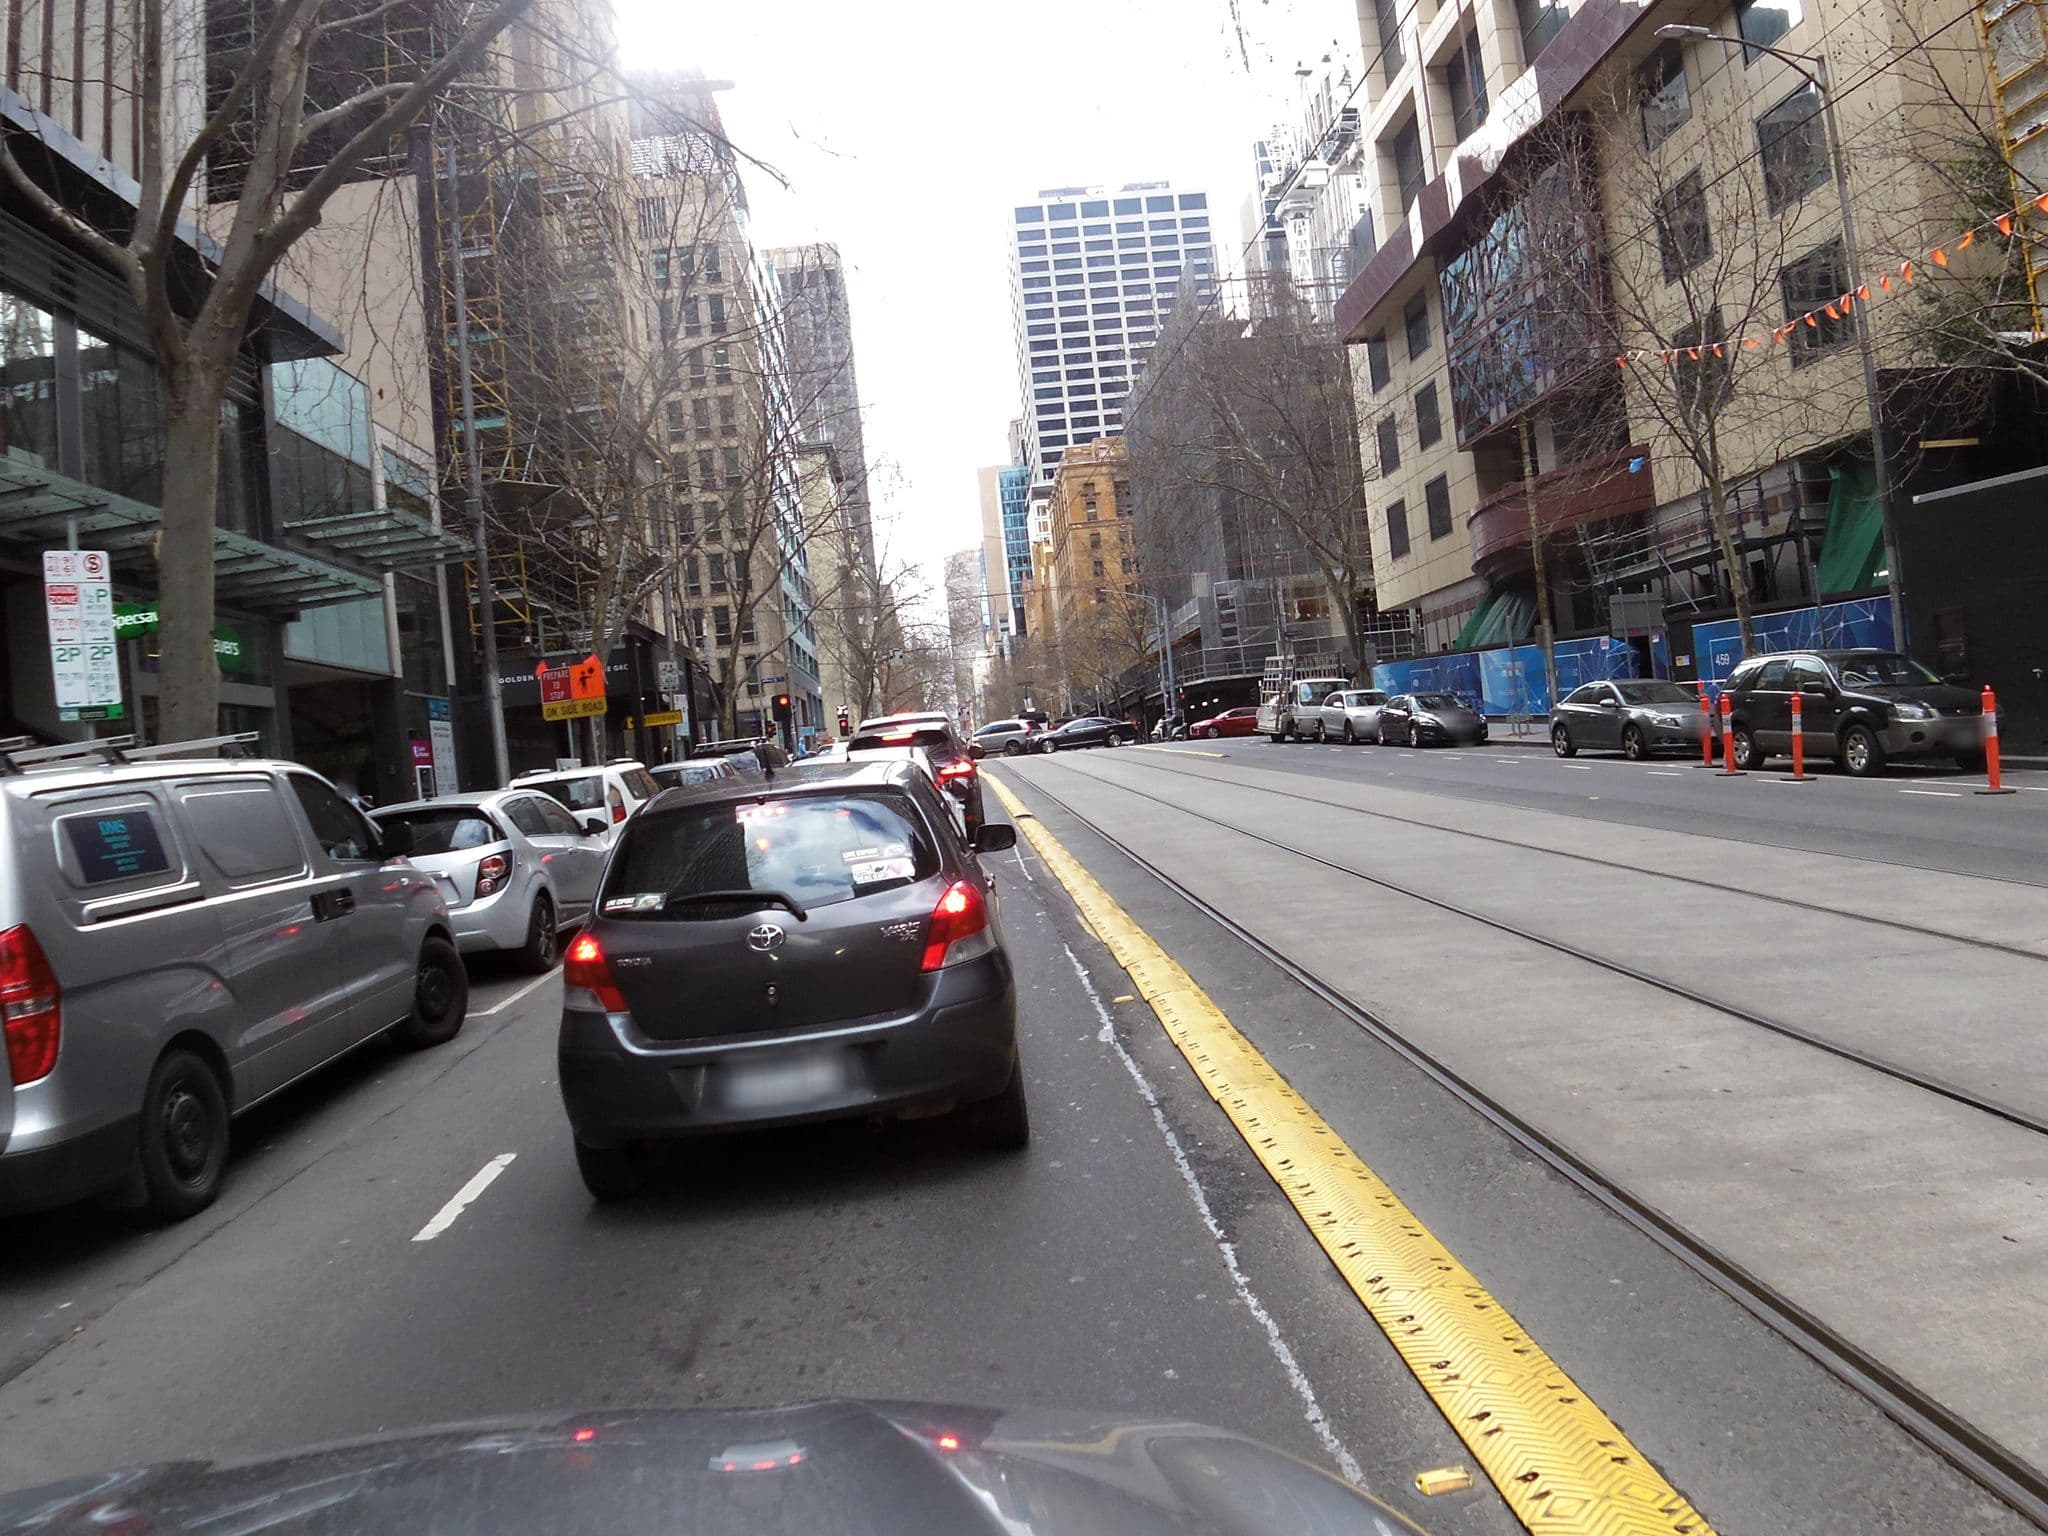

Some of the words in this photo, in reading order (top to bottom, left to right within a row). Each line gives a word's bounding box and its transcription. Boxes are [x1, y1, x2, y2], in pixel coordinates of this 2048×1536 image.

[56, 647, 81, 662] 2P
[90, 645, 113, 661] 2P
[1714, 653, 1731, 667] 459
[498, 674, 535, 684] GOLDEN
[542, 670, 570, 680] PREPARE
[552, 681, 562, 690] TO
[550, 691, 566, 700] STOP
[545, 707, 559, 717] ON
[560, 704, 579, 715] SIDE
[582, 700, 606, 712] ROAD
